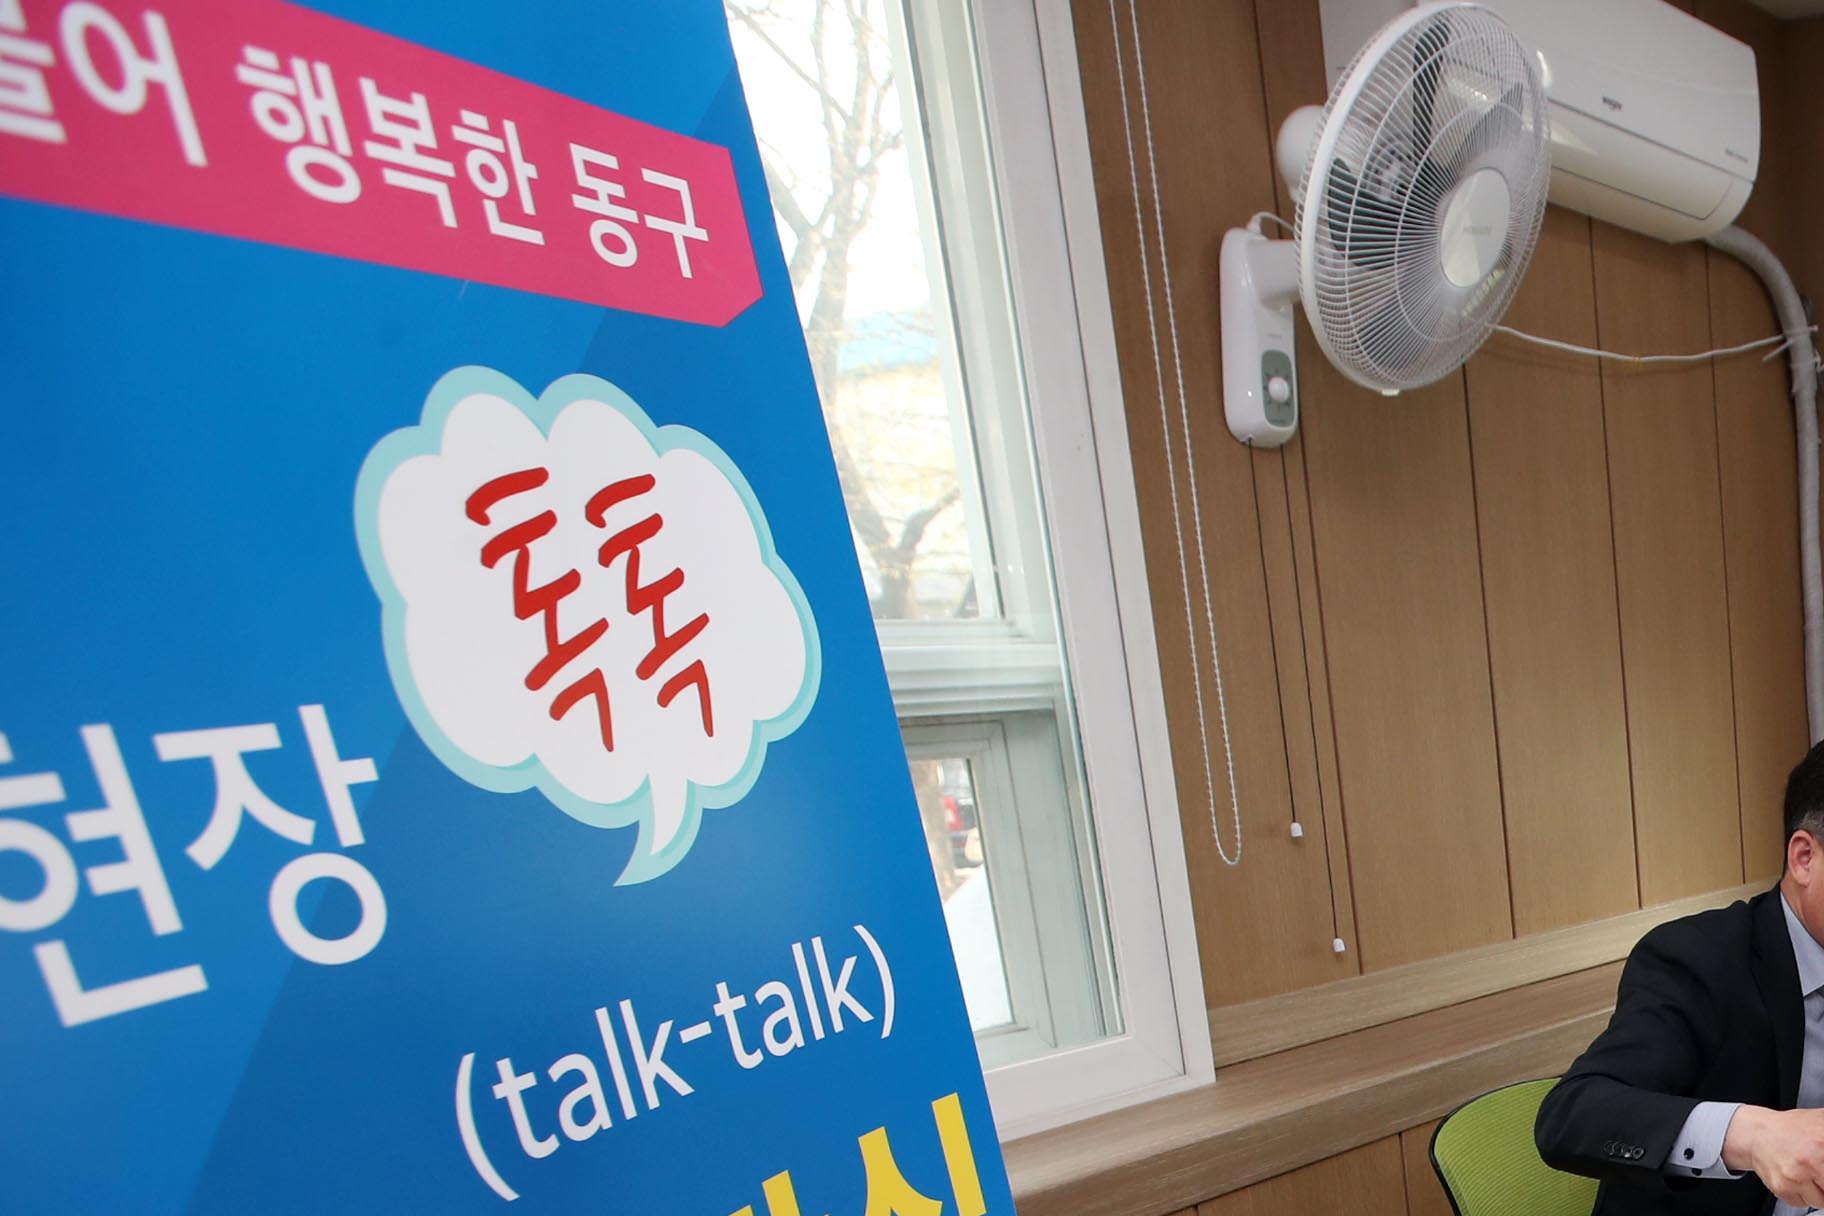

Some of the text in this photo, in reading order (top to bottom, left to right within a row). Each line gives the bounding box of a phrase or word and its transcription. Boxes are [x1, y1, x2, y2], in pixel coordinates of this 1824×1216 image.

[237, 45, 545, 246] 행복한
[569, 142, 709, 279] 동구
[465, 467, 714, 753] 톡톡
[0, 703, 387, 1028] 현장
[454, 924, 896, 1202] (talk-talk)
